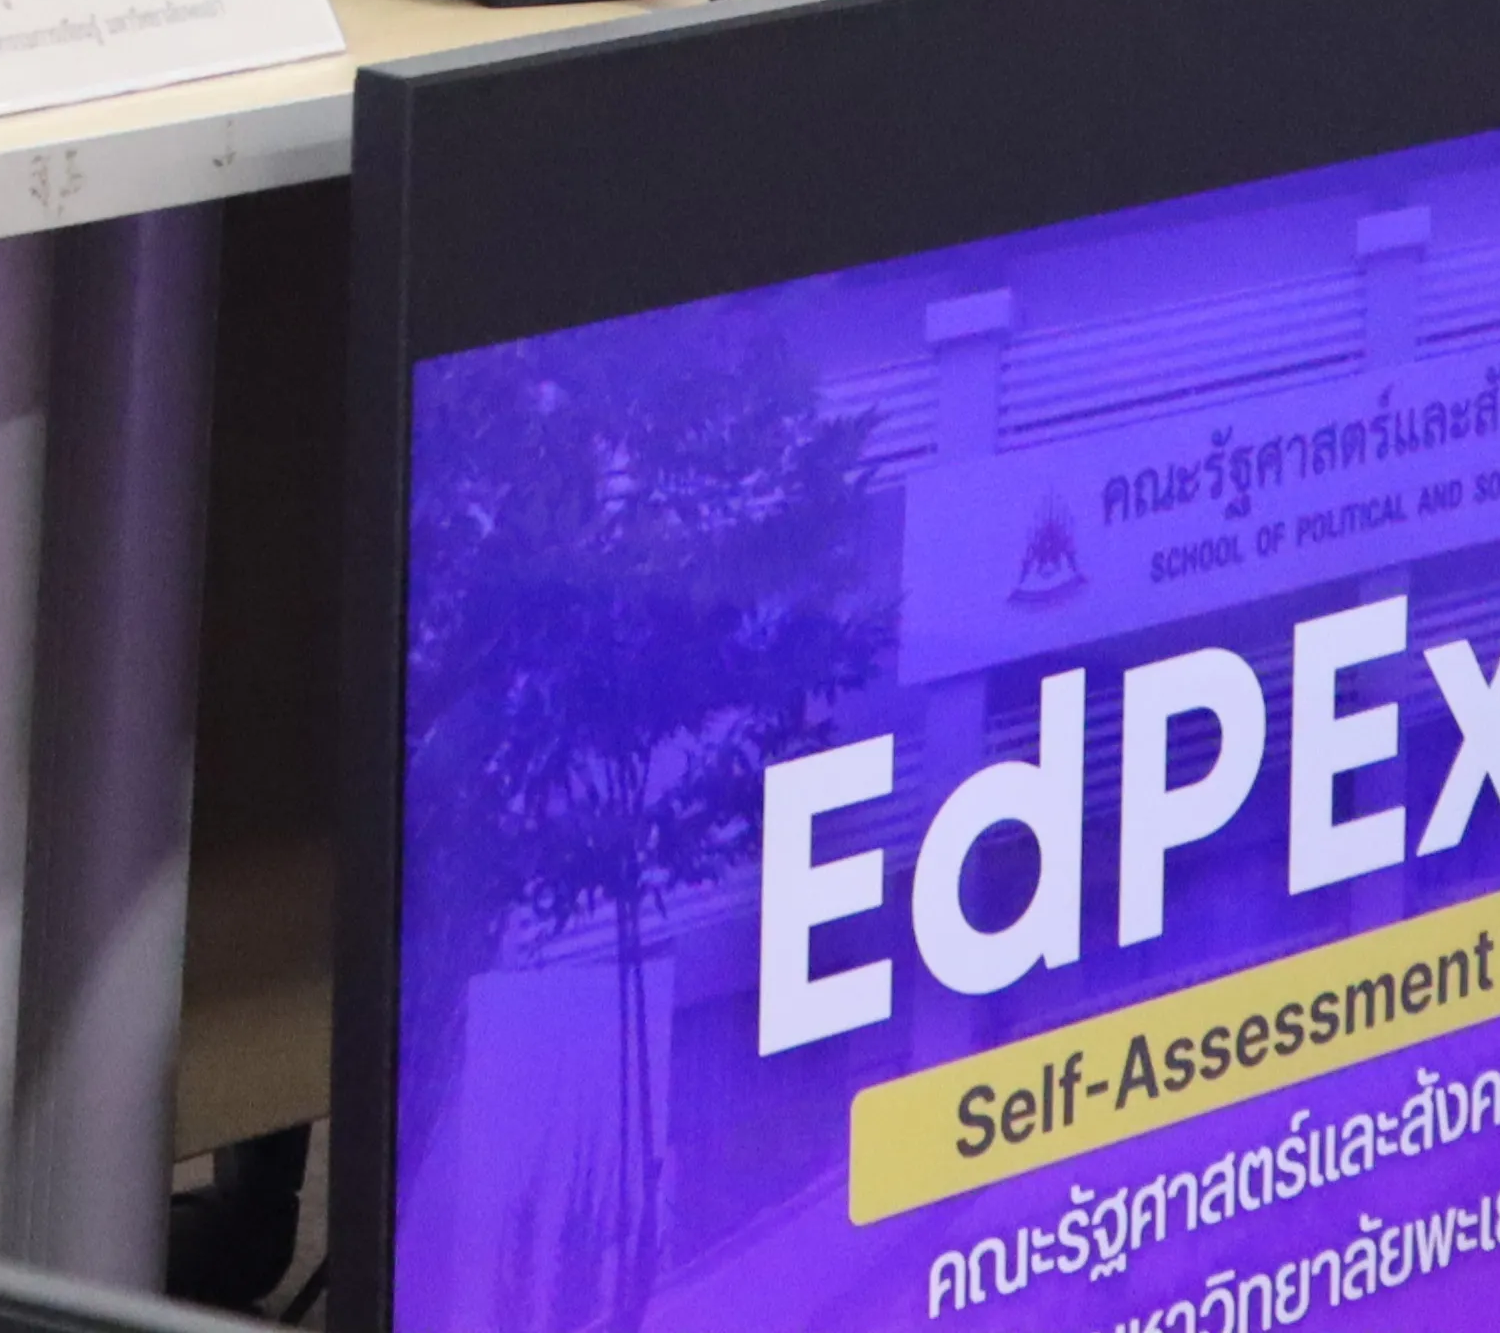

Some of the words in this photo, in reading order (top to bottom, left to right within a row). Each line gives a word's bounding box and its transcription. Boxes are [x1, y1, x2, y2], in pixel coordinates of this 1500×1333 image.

[1149, 536, 1245, 585] SCHOOL
[1256, 520, 1290, 559] OF
[1294, 494, 1410, 547] POLITICAL
[1416, 479, 1465, 515] AND
[954, 933, 1496, 1161] Self-Assessment
